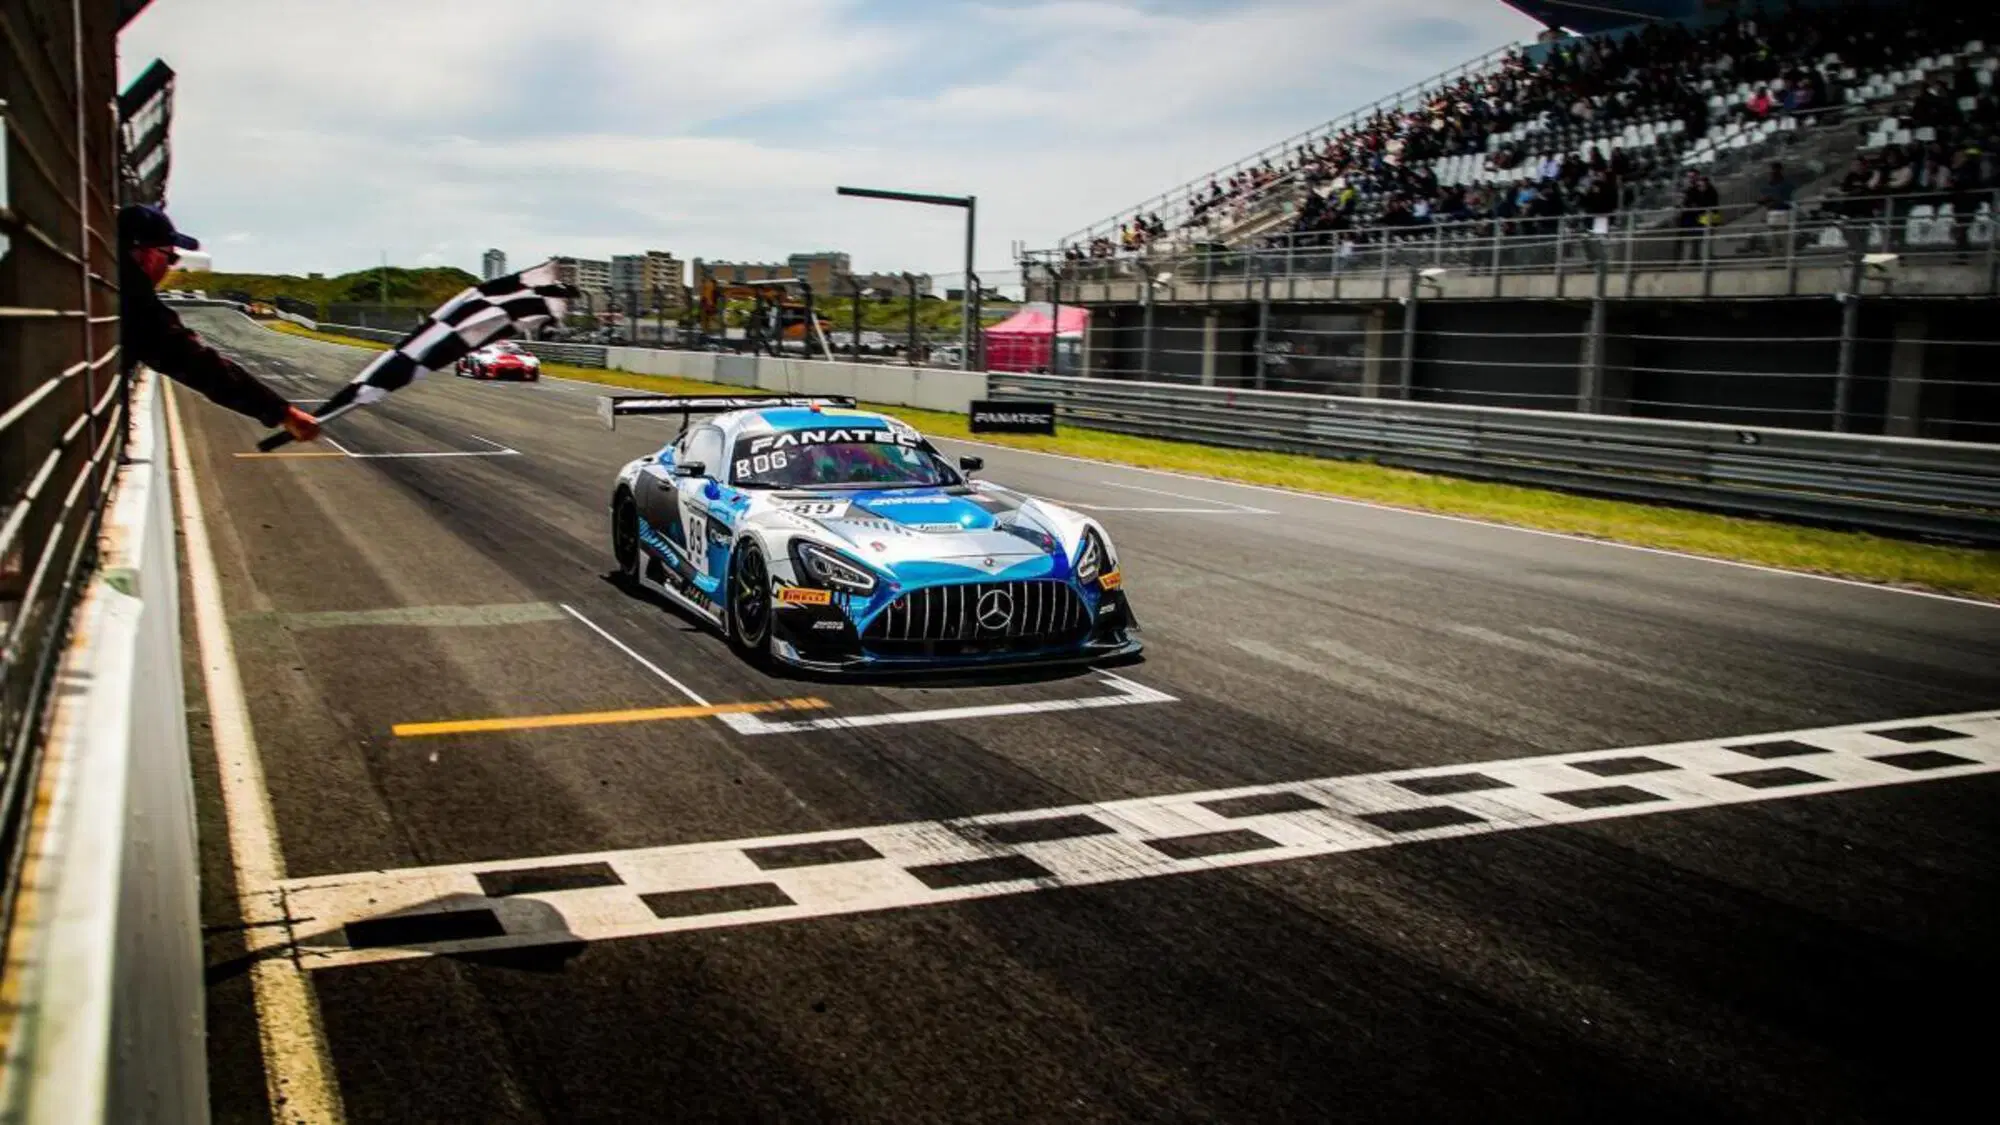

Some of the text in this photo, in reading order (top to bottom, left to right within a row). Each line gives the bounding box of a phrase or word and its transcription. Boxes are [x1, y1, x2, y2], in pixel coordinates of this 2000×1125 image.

[974, 412, 1051, 424] FANATEC
[750, 429, 917, 453] FANATEC
[793, 503, 834, 514] 89
[689, 516, 703, 554] 89
